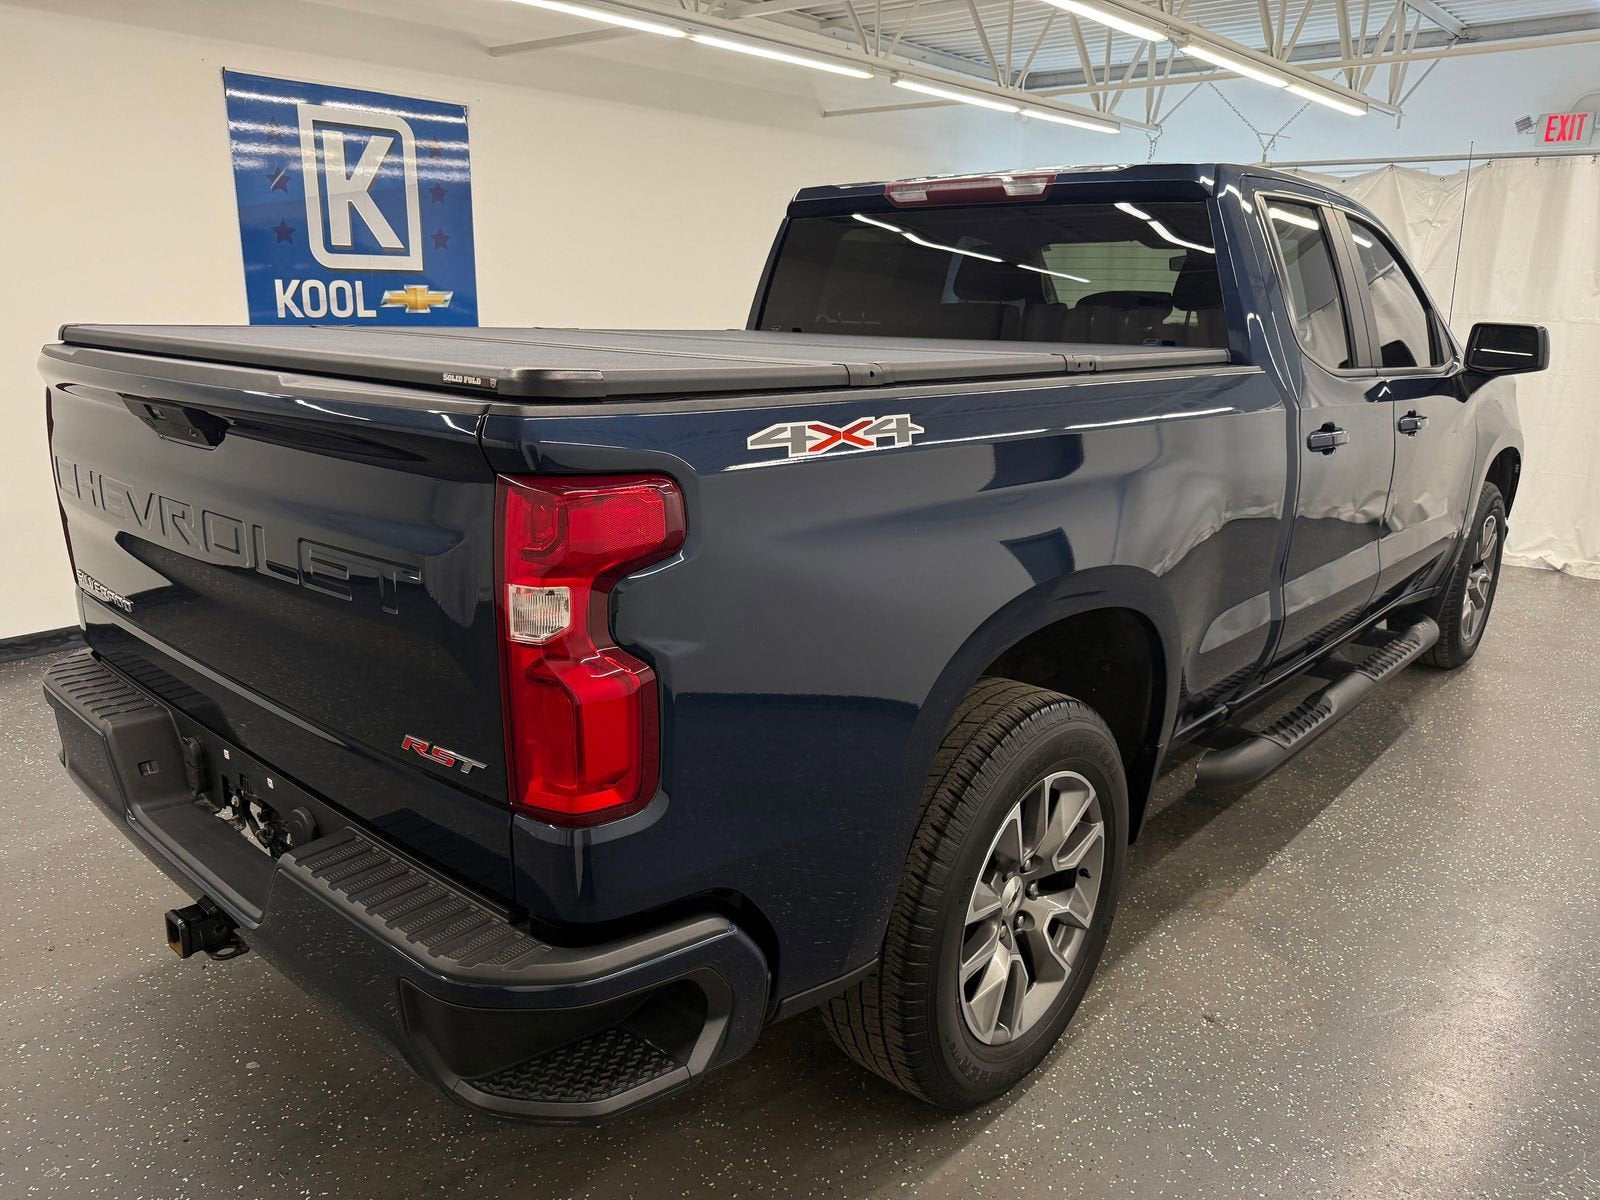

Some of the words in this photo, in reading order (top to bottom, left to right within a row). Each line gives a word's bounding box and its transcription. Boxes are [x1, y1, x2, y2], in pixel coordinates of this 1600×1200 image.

[1544, 113, 1588, 142] EXIT
[322, 129, 405, 249] K
[274, 279, 377, 318] KOOL
[442, 372, 463, 383] SOLID
[463, 375, 482, 385] FOLD
[54, 455, 421, 614] CHEVROLET
[401, 734, 488, 774] RST
